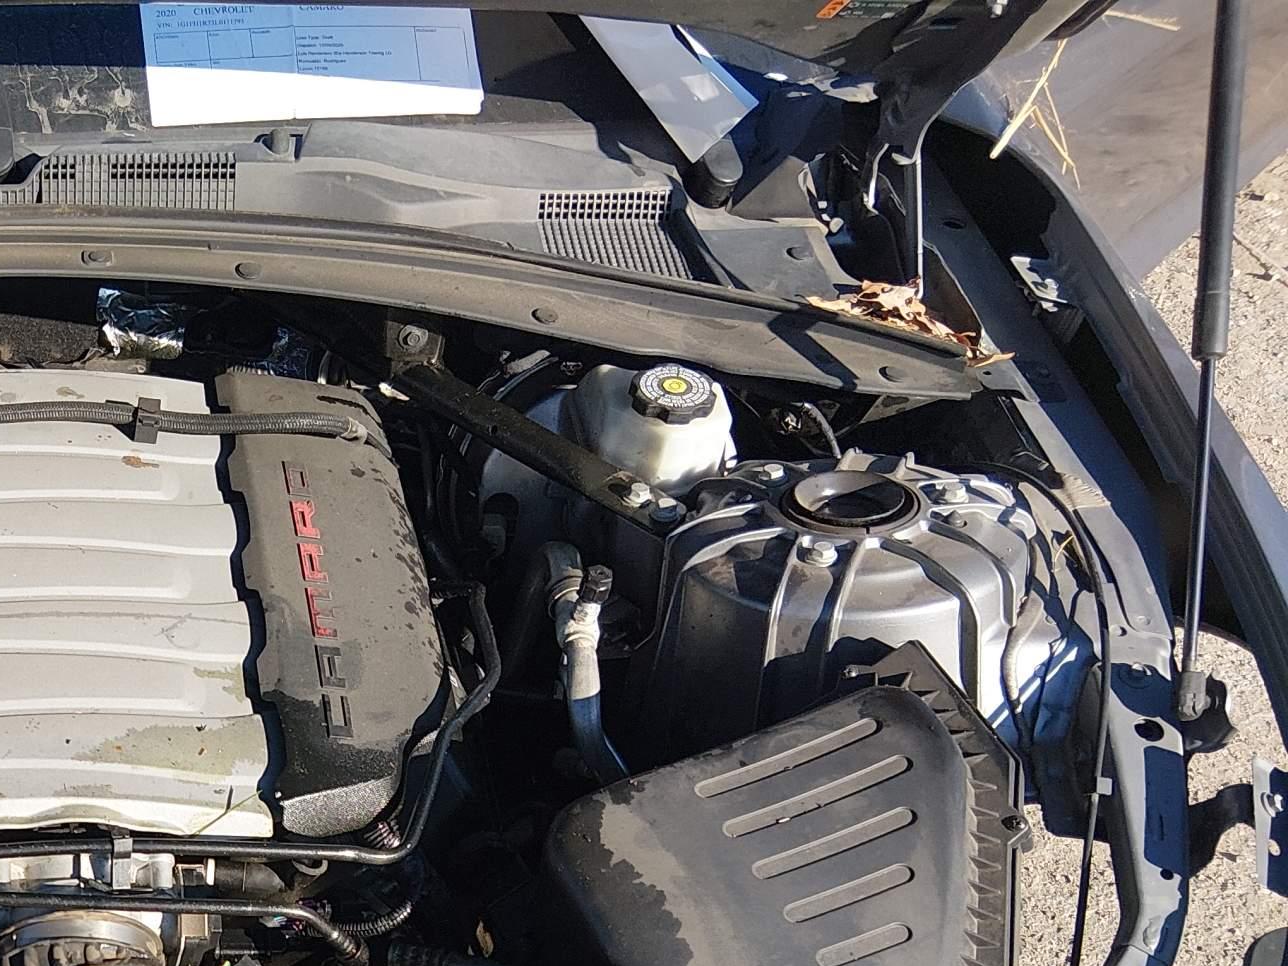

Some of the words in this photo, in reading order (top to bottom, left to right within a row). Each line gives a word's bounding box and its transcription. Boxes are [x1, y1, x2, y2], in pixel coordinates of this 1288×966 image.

[155, 9, 177, 18] 2020
[193, 5, 255, 16] CHEVROLET
[157, 21, 173, 29] VIN:
[281, 459, 354, 739] CAMARO
